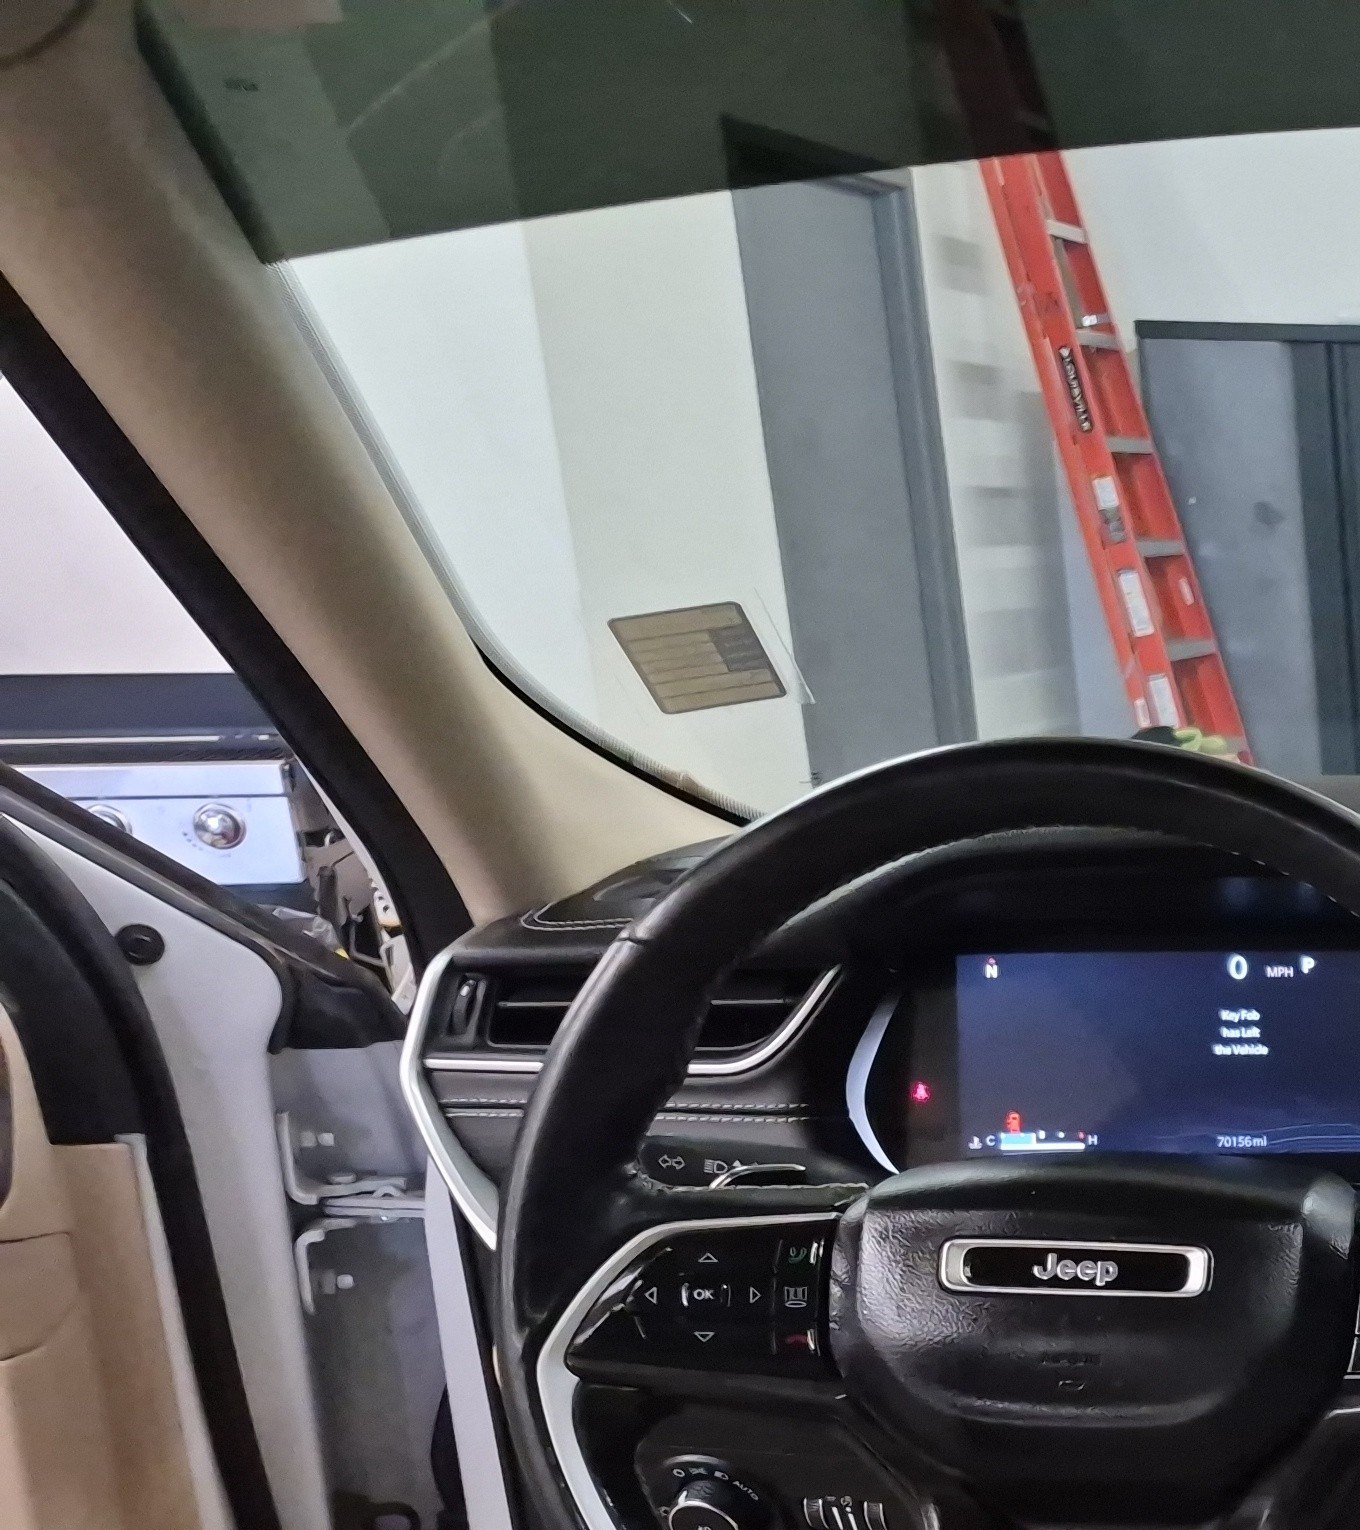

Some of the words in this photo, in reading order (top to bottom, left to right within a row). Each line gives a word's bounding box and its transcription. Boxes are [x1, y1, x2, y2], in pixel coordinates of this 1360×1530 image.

[985, 964, 998, 979] N
[1265, 965, 1294, 978] MPH
[1300, 954, 1315, 974] P
[1220, 1009, 1240, 1023] Key
[1241, 1009, 1260, 1021] Fob
[1232, 1044, 1269, 1055] Vehicle
[1088, 1134, 1098, 1146] H
[1032, 1253, 1118, 1286] Jeep
[694, 1289, 714, 1300] OK
[732, 1480, 759, 1501] AUTO
